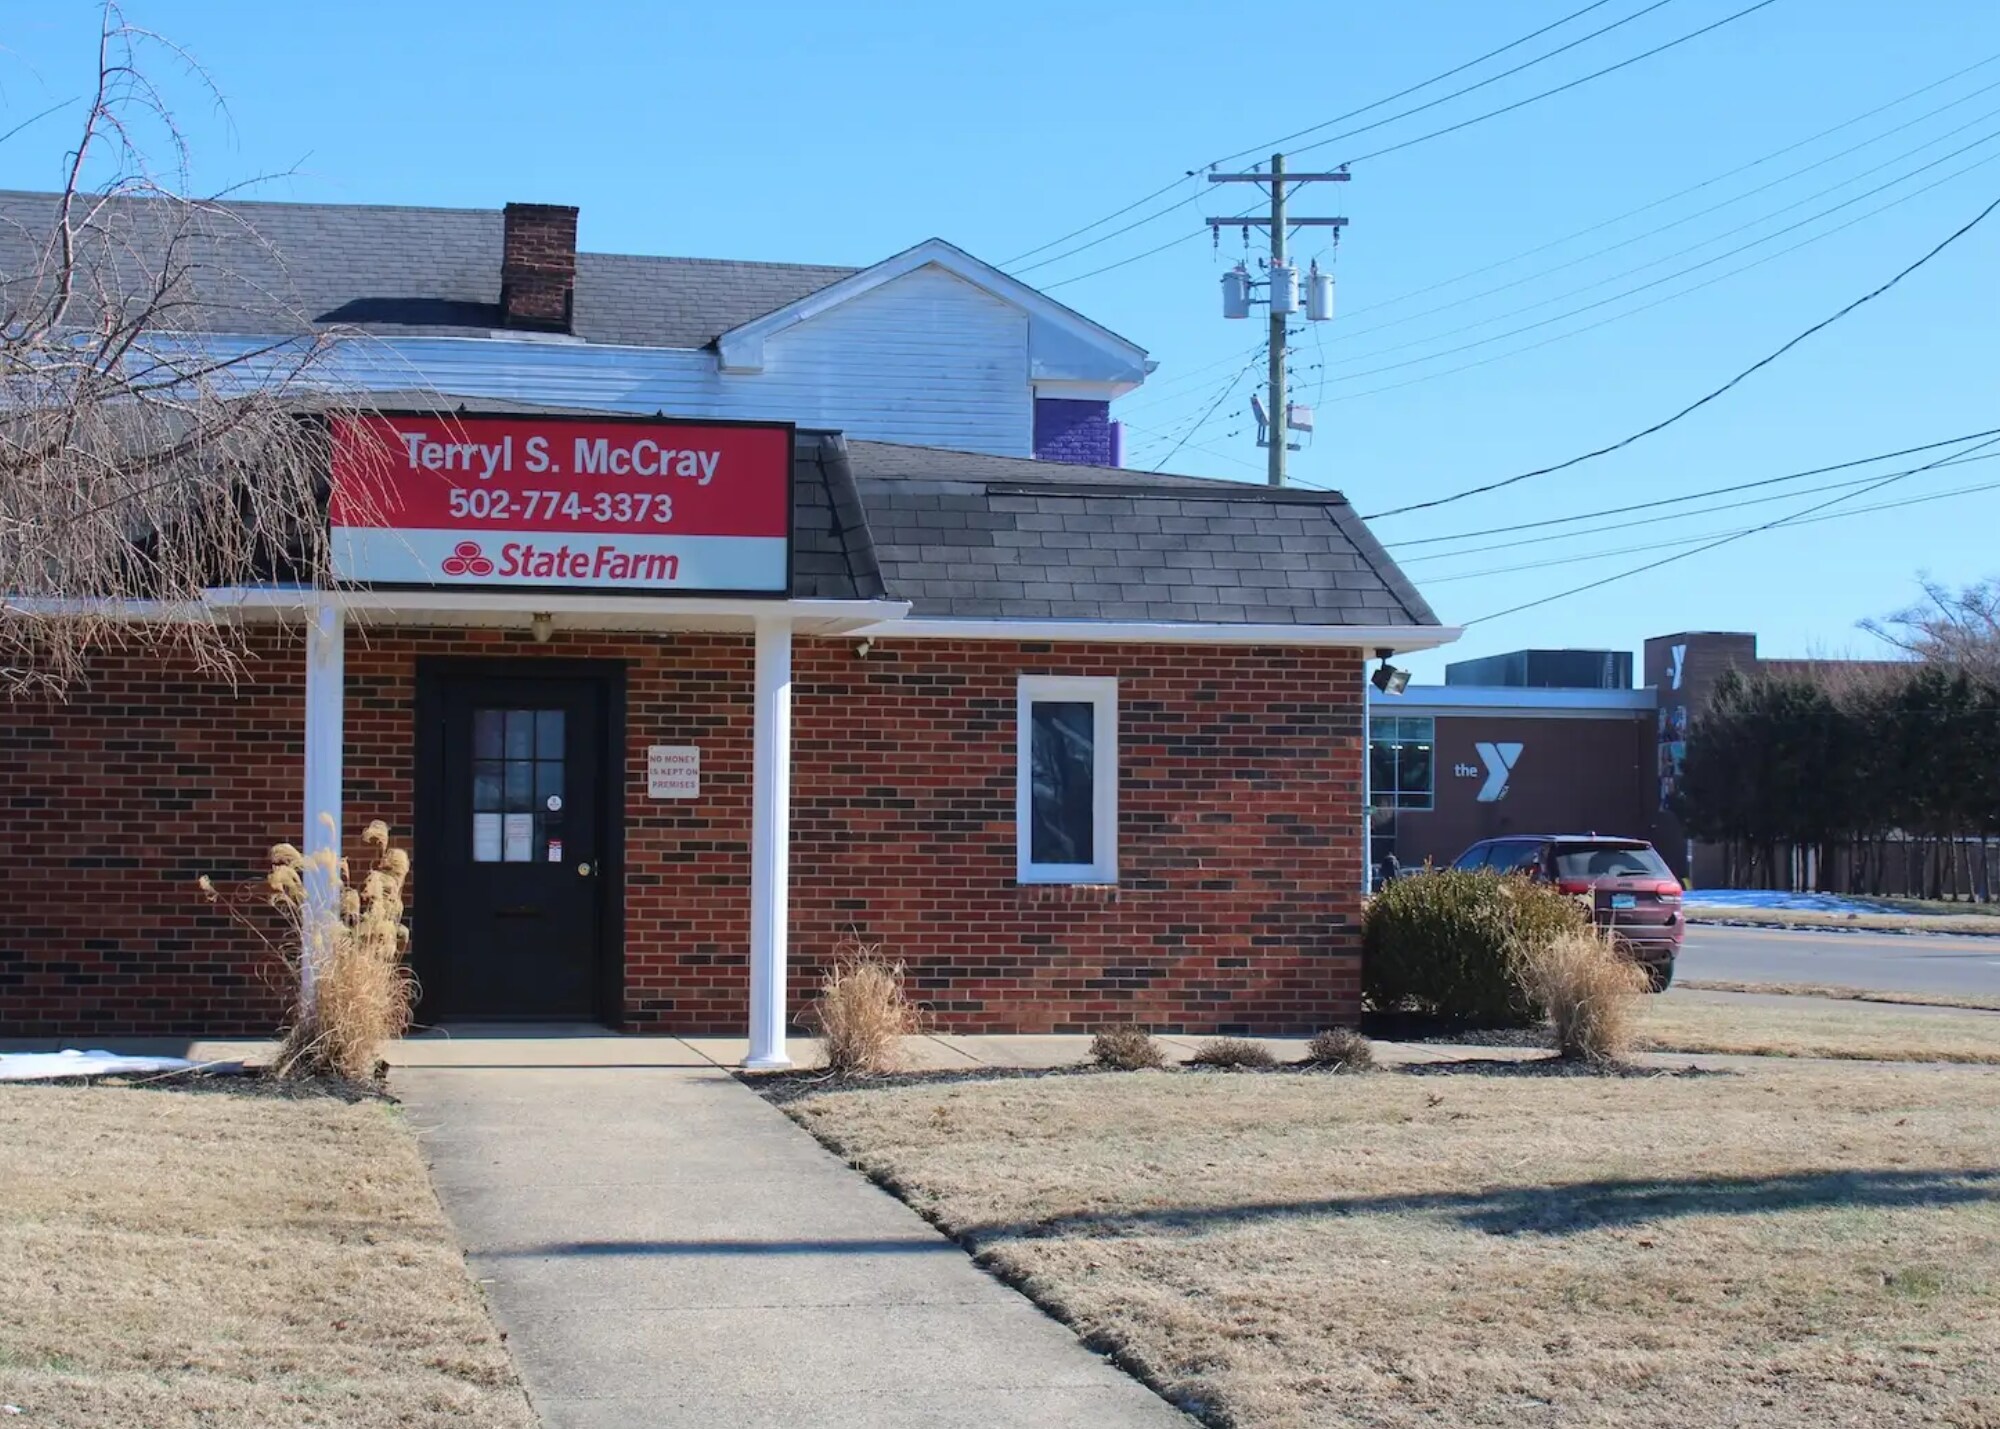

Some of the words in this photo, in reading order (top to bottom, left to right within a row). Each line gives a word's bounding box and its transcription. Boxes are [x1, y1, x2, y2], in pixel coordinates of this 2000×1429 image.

[401, 432, 513, 480] Terryl
[525, 436, 560, 473] S.
[574, 437, 721, 486] McCray
[449, 488, 673, 523] 502-774-3373
[650, 755, 662, 763] NO
[664, 755, 696, 764] MONEY
[685, 768, 698, 776] ON
[1454, 763, 1478, 777] the
[652, 780, 696, 789] PREMISES
